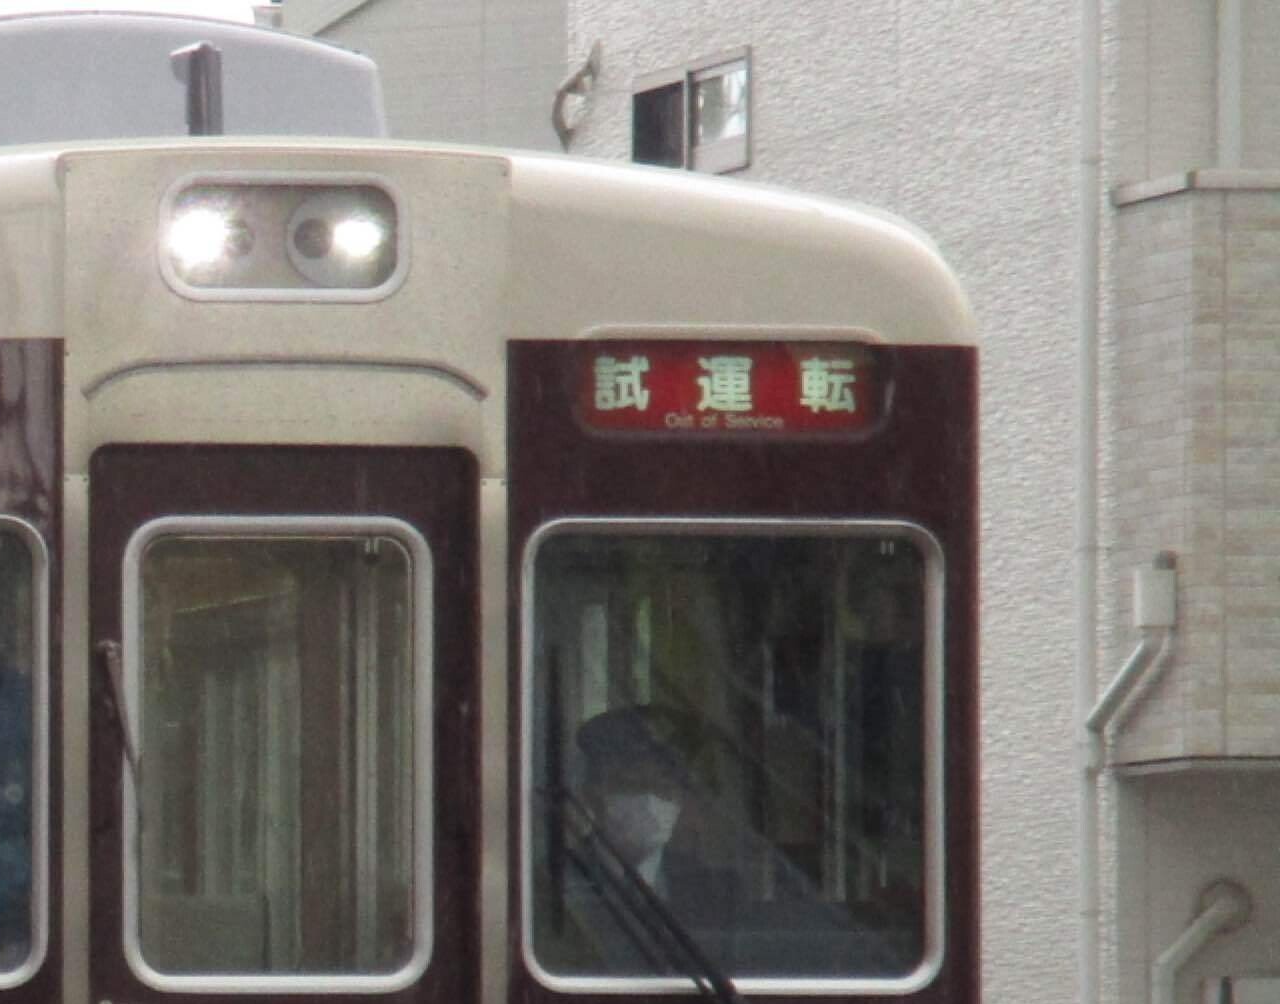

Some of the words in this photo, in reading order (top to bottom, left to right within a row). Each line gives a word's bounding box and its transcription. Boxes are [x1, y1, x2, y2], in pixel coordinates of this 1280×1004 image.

[594, 355, 857, 413] 試運転
[665, 413, 692, 428] Out
[701, 413, 718, 428] of
[725, 413, 784, 429] Service
